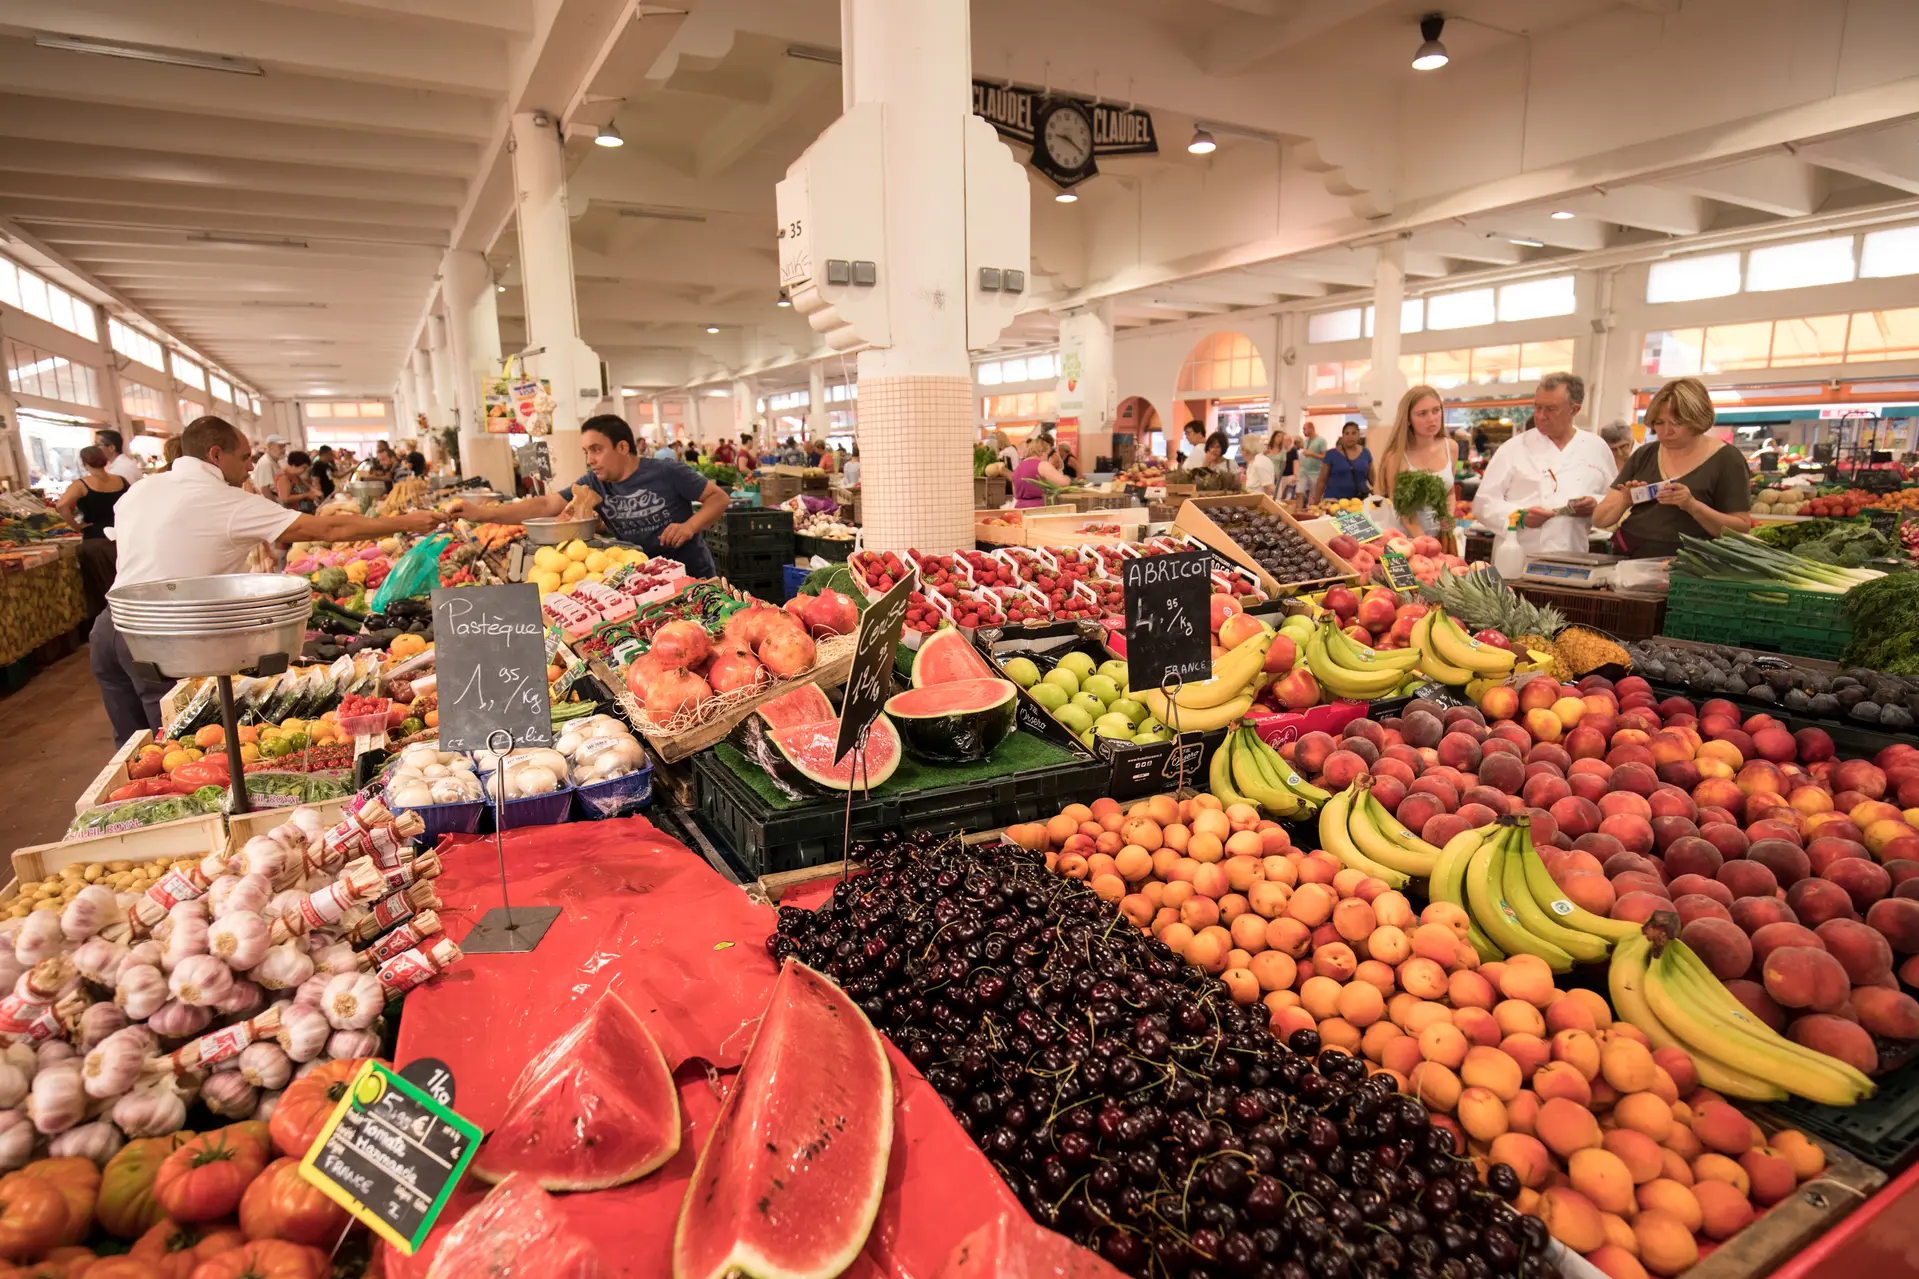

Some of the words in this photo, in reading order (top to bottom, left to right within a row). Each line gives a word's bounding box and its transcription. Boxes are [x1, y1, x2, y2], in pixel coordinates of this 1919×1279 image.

[972, 85, 1034, 131] CLAUDEL
[1094, 108, 1151, 143] CLAUDEL
[790, 220, 802, 239] 35
[601, 489, 665, 519] Super
[1128, 556, 1212, 587] ABRICOT
[438, 597, 543, 648] Pastèque
[859, 599, 907, 656] Cerise
[1164, 660, 1207, 676] FRANCE
[1271, 731, 1290, 750] Pink
[1171, 750, 1200, 767] Osero
[106, 818, 144, 834] ROYAL
[361, 1117, 407, 1158] Tomate
[324, 1154, 375, 1195] FRANCE
[356, 1135, 418, 1185] Marmande
